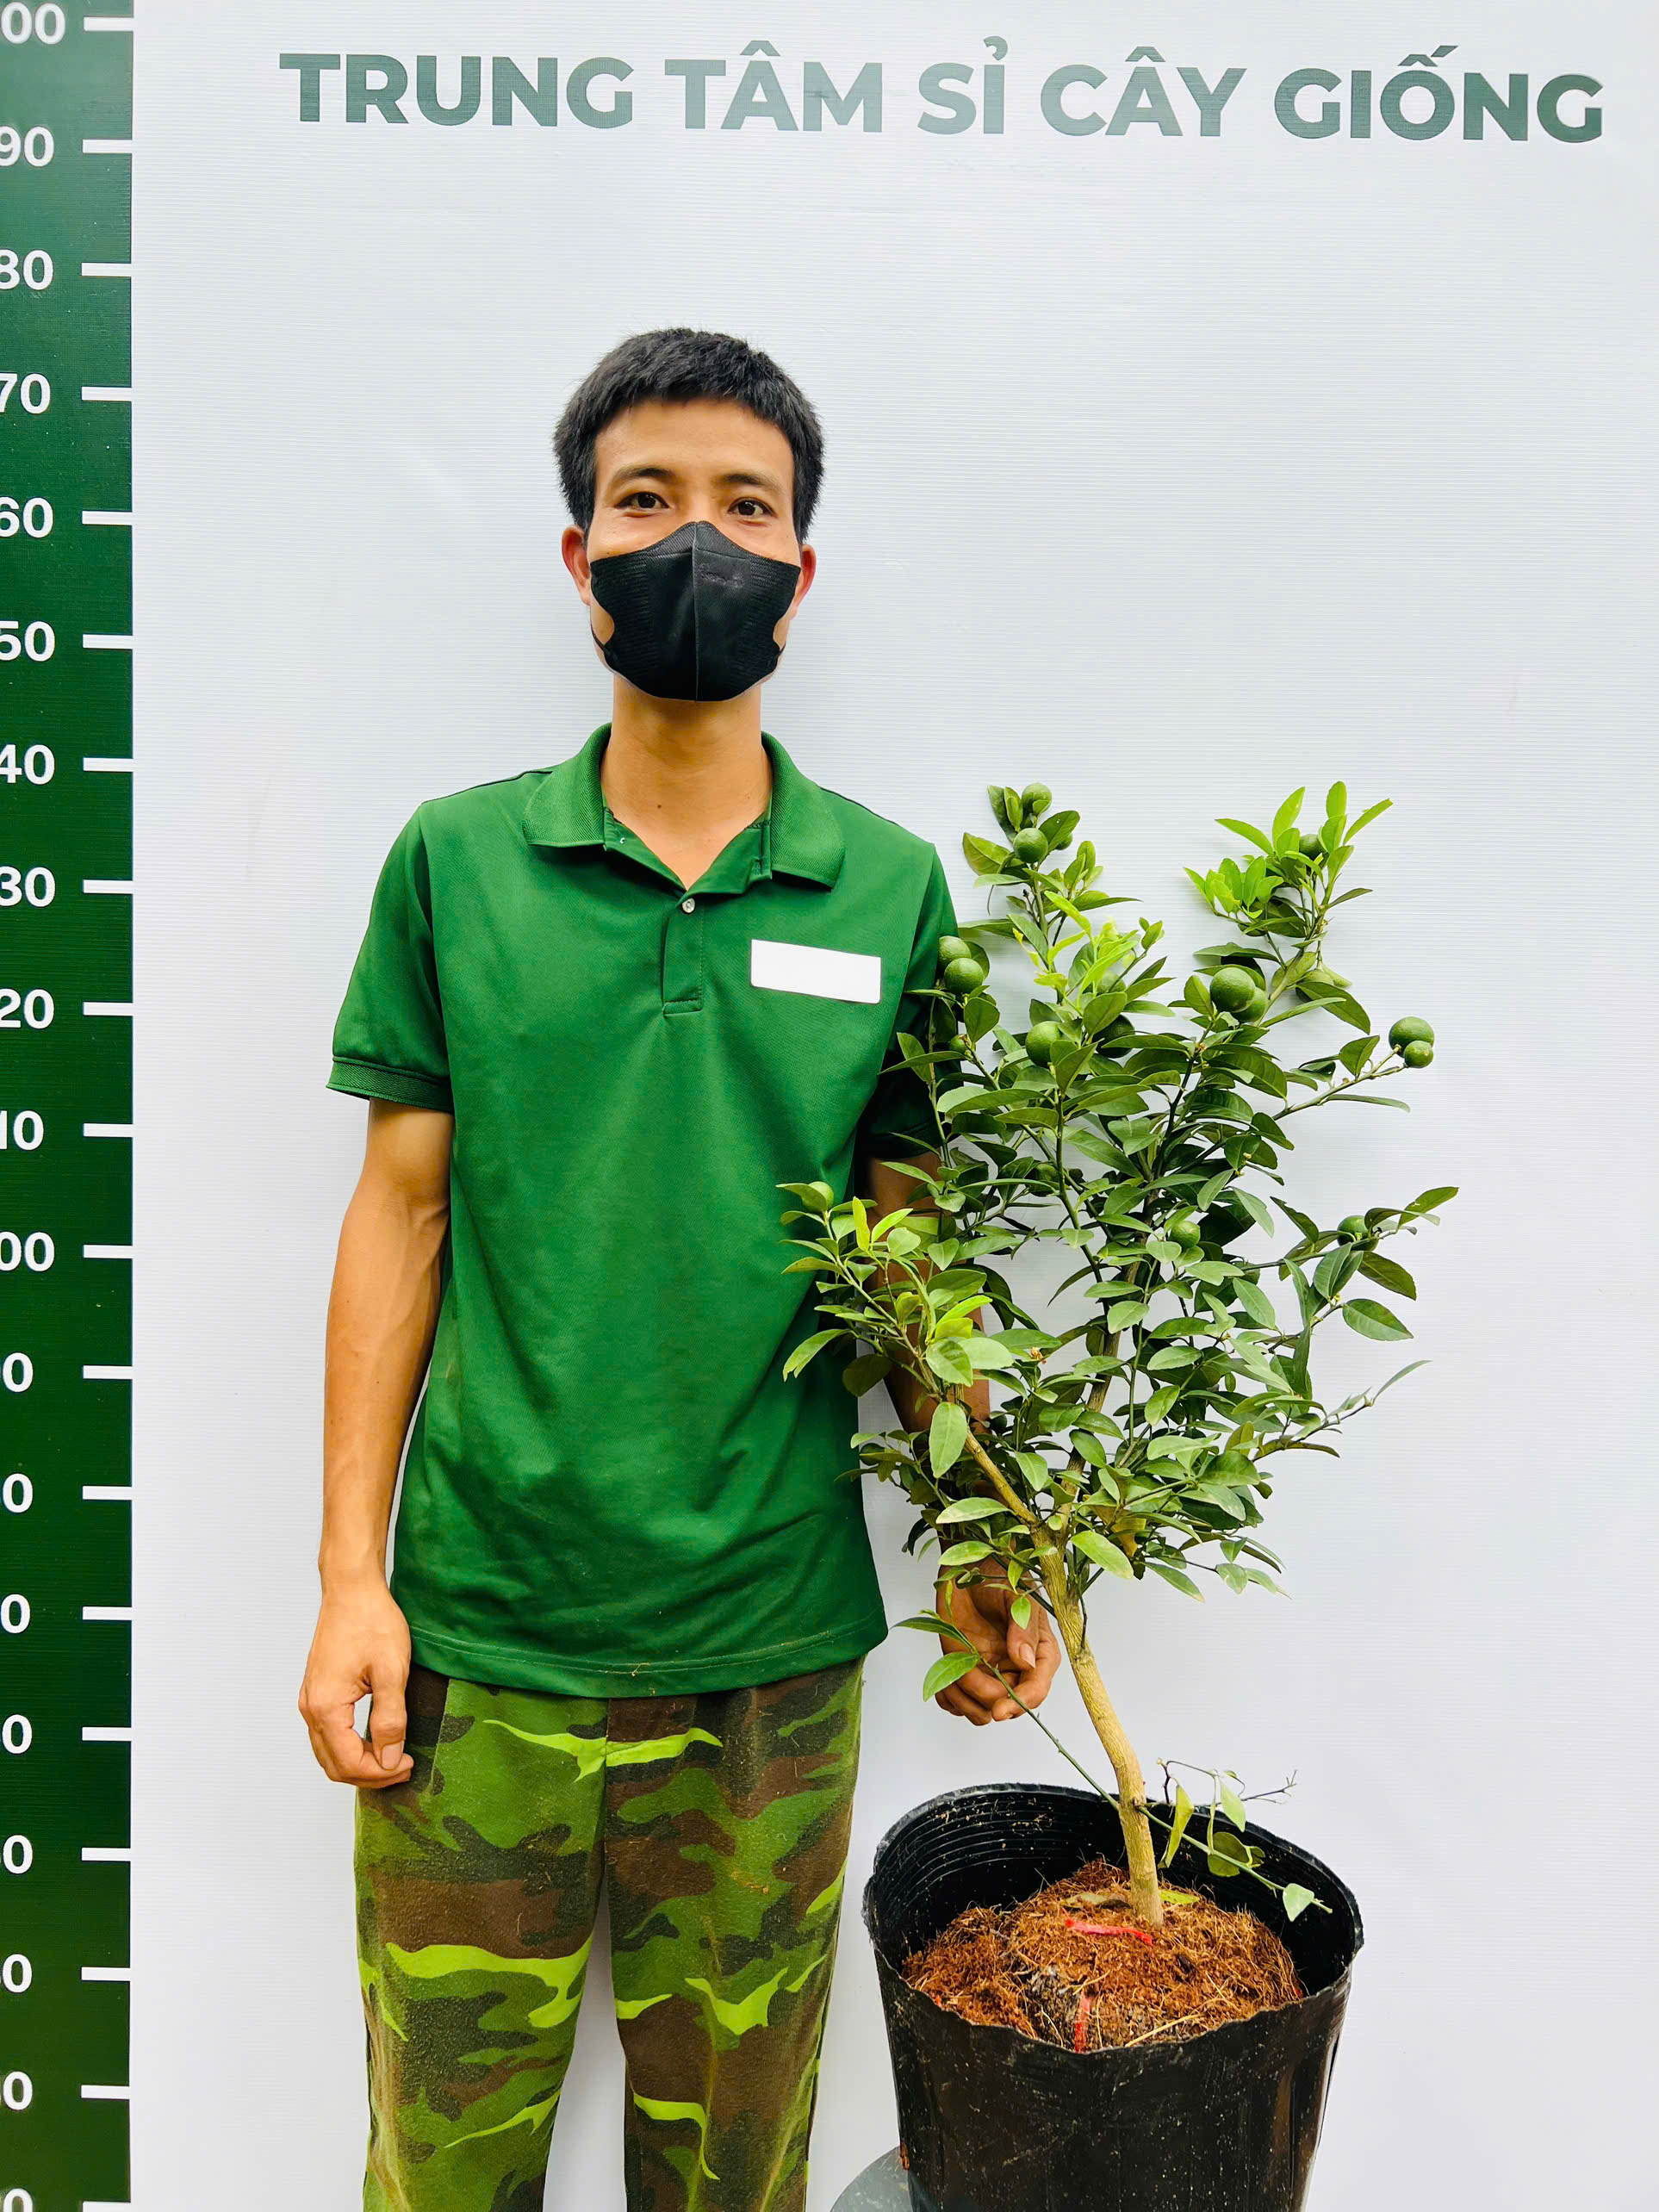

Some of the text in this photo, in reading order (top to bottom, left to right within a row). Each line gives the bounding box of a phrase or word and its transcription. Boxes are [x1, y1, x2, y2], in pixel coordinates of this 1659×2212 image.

[279, 36, 1604, 144] TRUNG TÂM SỈ CÂY GIỐNG
